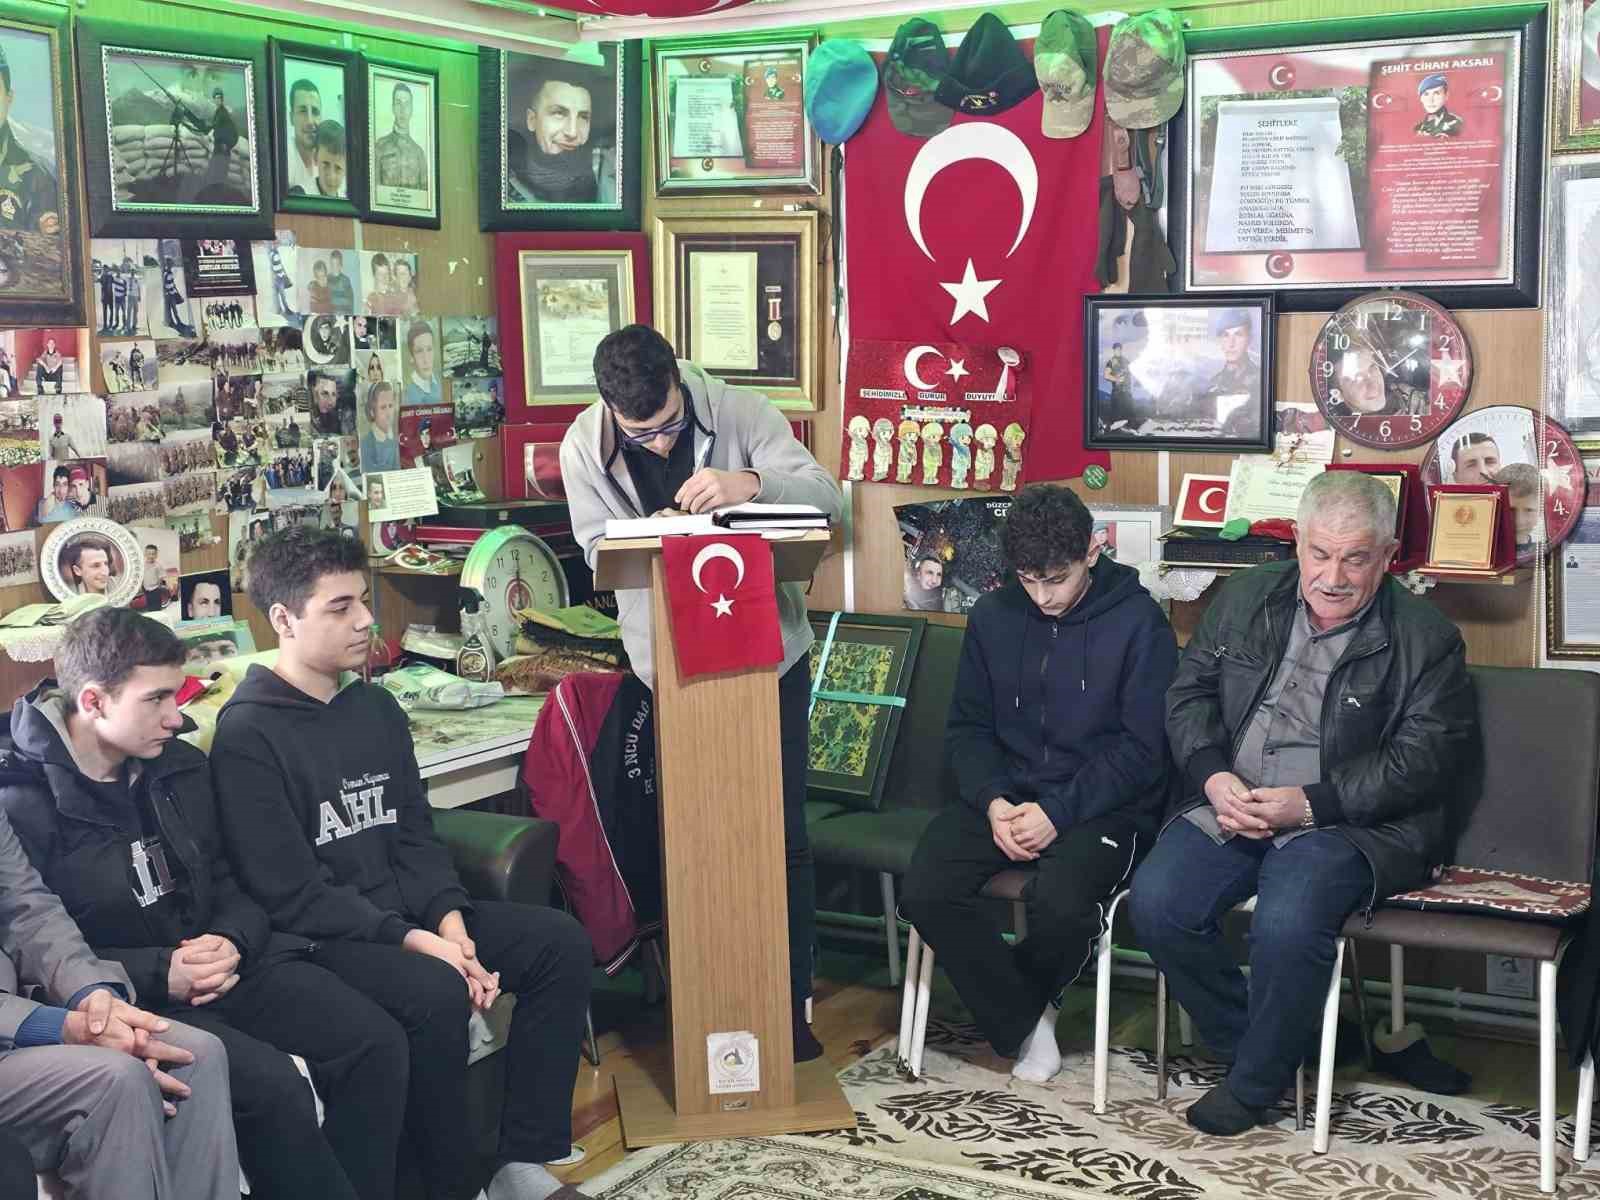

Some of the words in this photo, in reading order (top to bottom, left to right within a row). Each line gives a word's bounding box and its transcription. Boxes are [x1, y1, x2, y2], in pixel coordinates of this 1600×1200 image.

[1414, 61, 1449, 71] CİHAN
[1383, 304, 1402, 320] 12
[1356, 313, 1369, 330] 11
[1419, 315, 1425, 330] 1
[1334, 335, 1350, 351] 10
[1439, 336, 1450, 351] 2
[1322, 361, 1334, 377] 9
[1329, 389, 1342, 405] 8
[1433, 393, 1446, 409] 4
[1351, 412, 1362, 428] 7
[1409, 415, 1422, 431] 5
[1379, 421, 1392, 437] 6
[1460, 434, 1471, 450] 11
[1547, 441, 1560, 457] 2
[1553, 499, 1565, 515] 4
[496, 557, 504, 569] 11
[511, 549, 520, 561] 12
[529, 554, 534, 565] 1
[486, 576, 497, 589] 10
[542, 571, 549, 583] 2
[484, 601, 490, 613] 9
[548, 593, 554, 605] 3
[505, 640, 512, 652] 7
[627, 767, 641, 779] 3
[315, 786, 397, 847] AHL
